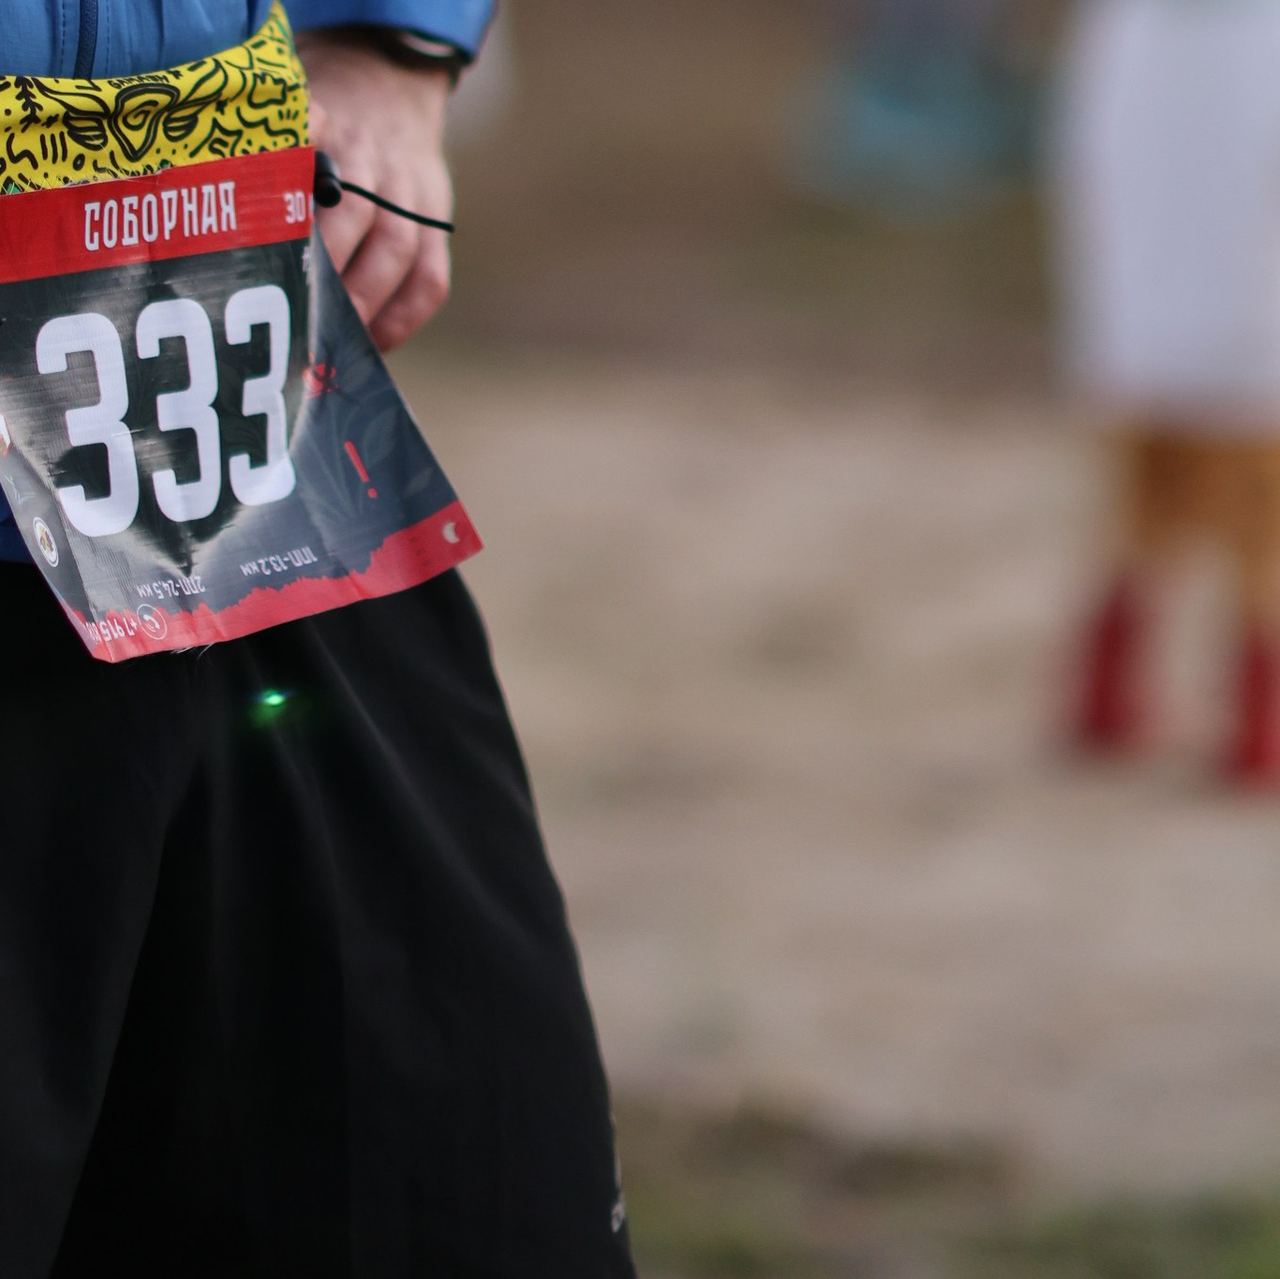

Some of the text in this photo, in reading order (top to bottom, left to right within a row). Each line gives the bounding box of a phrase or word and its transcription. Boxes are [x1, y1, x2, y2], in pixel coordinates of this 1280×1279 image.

[85, 181, 237, 251] СОБОРНАЯ
[283, 191, 306, 224] 30
[35, 285, 297, 537] 333
[99, 618, 125, 642] 915
